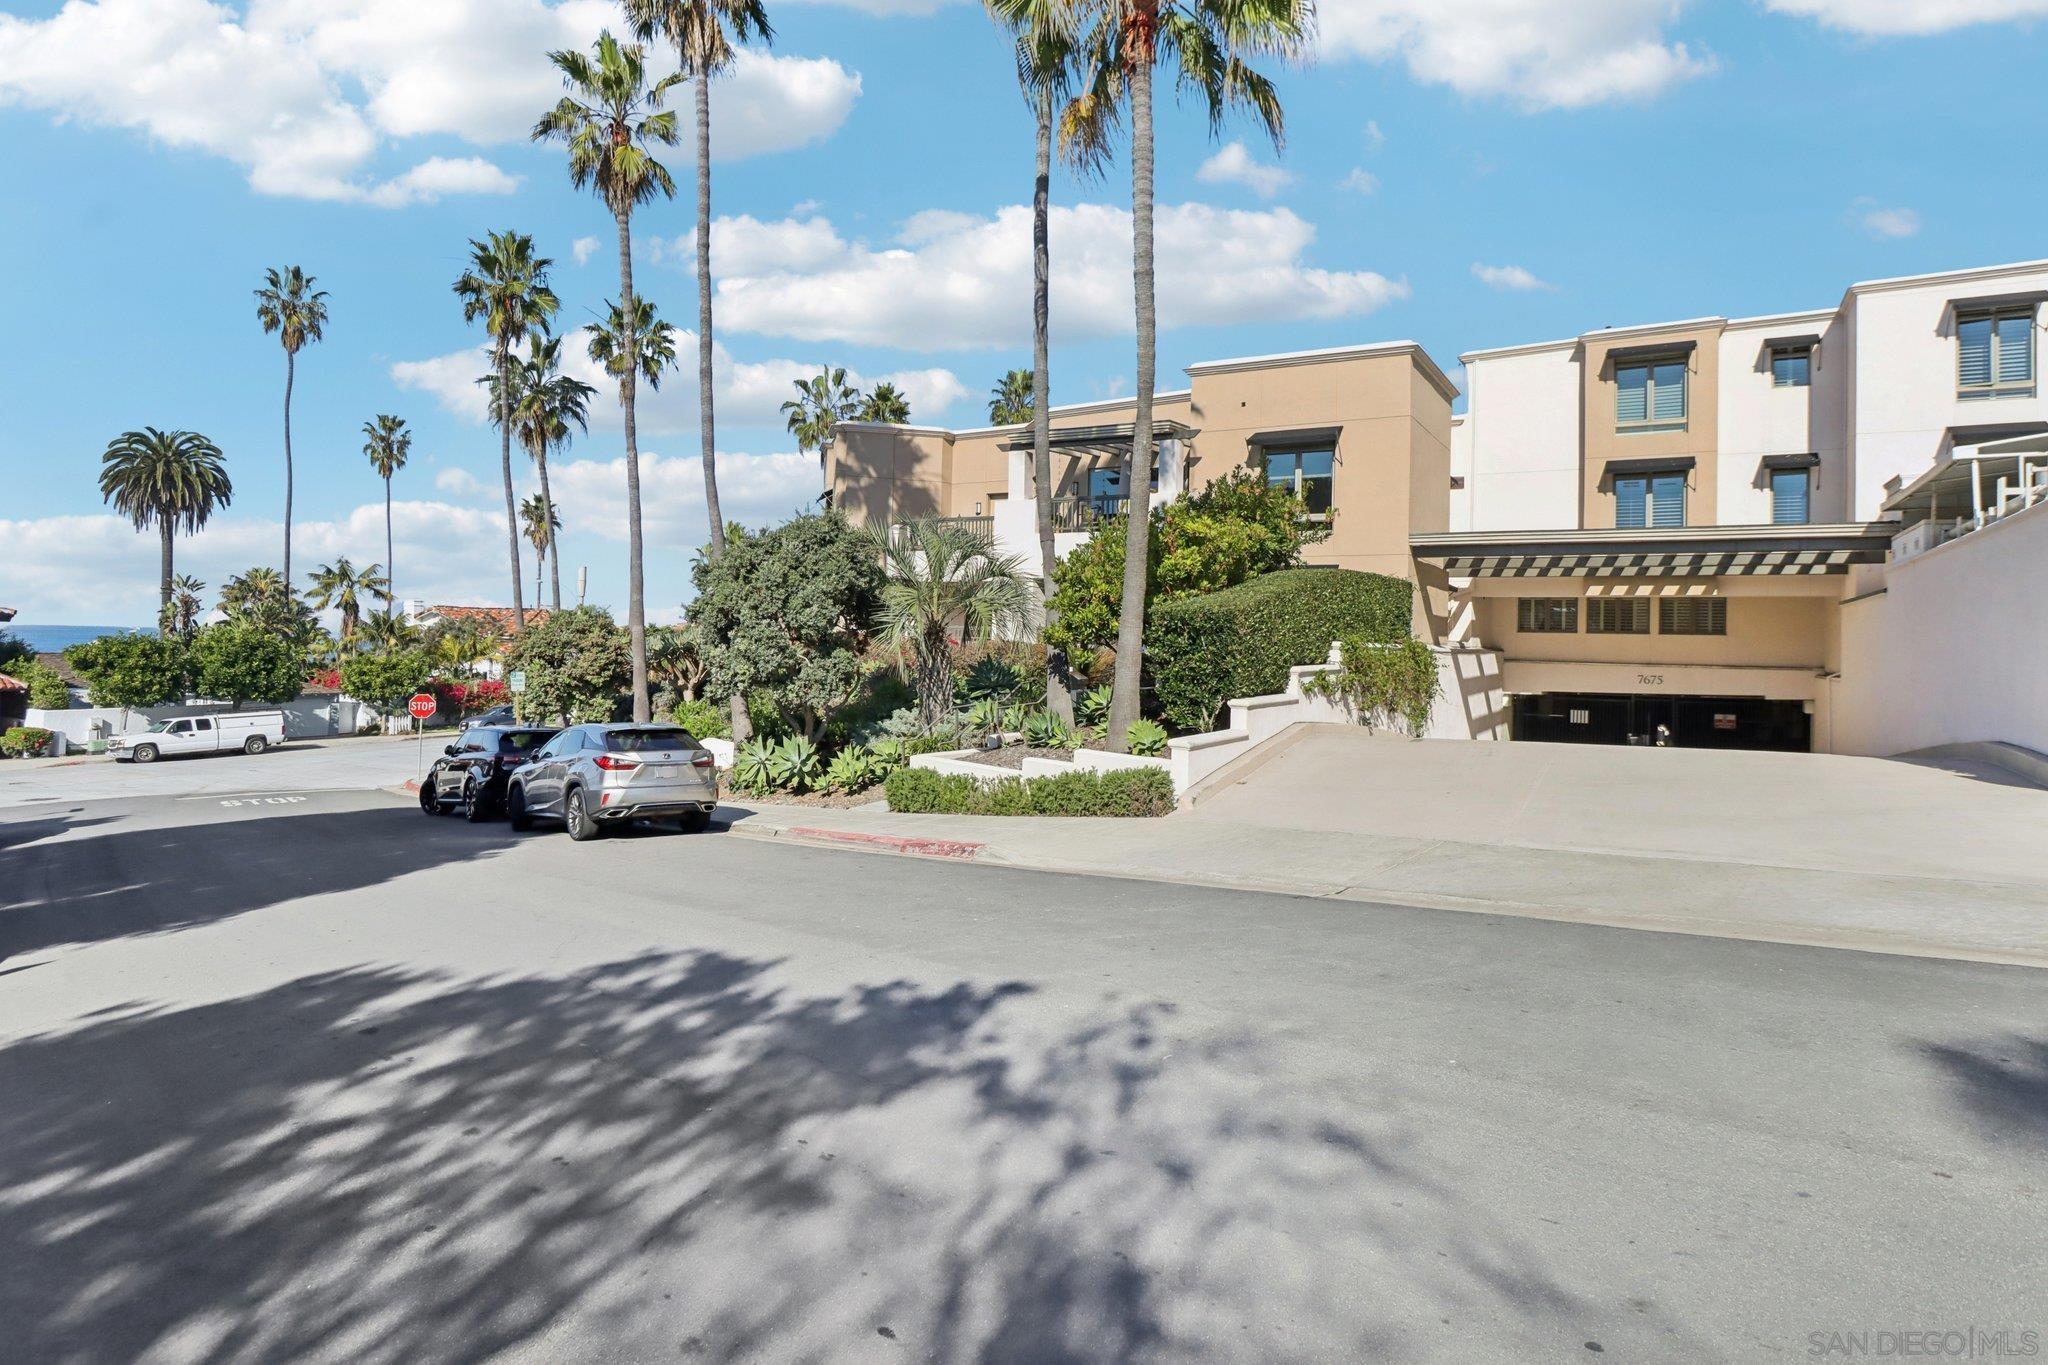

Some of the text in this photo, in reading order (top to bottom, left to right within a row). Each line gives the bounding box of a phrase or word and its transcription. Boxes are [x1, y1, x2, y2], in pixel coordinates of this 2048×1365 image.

[1637, 674, 1663, 685] 7675
[411, 701, 434, 711] STOP
[220, 796, 307, 807] STOP
